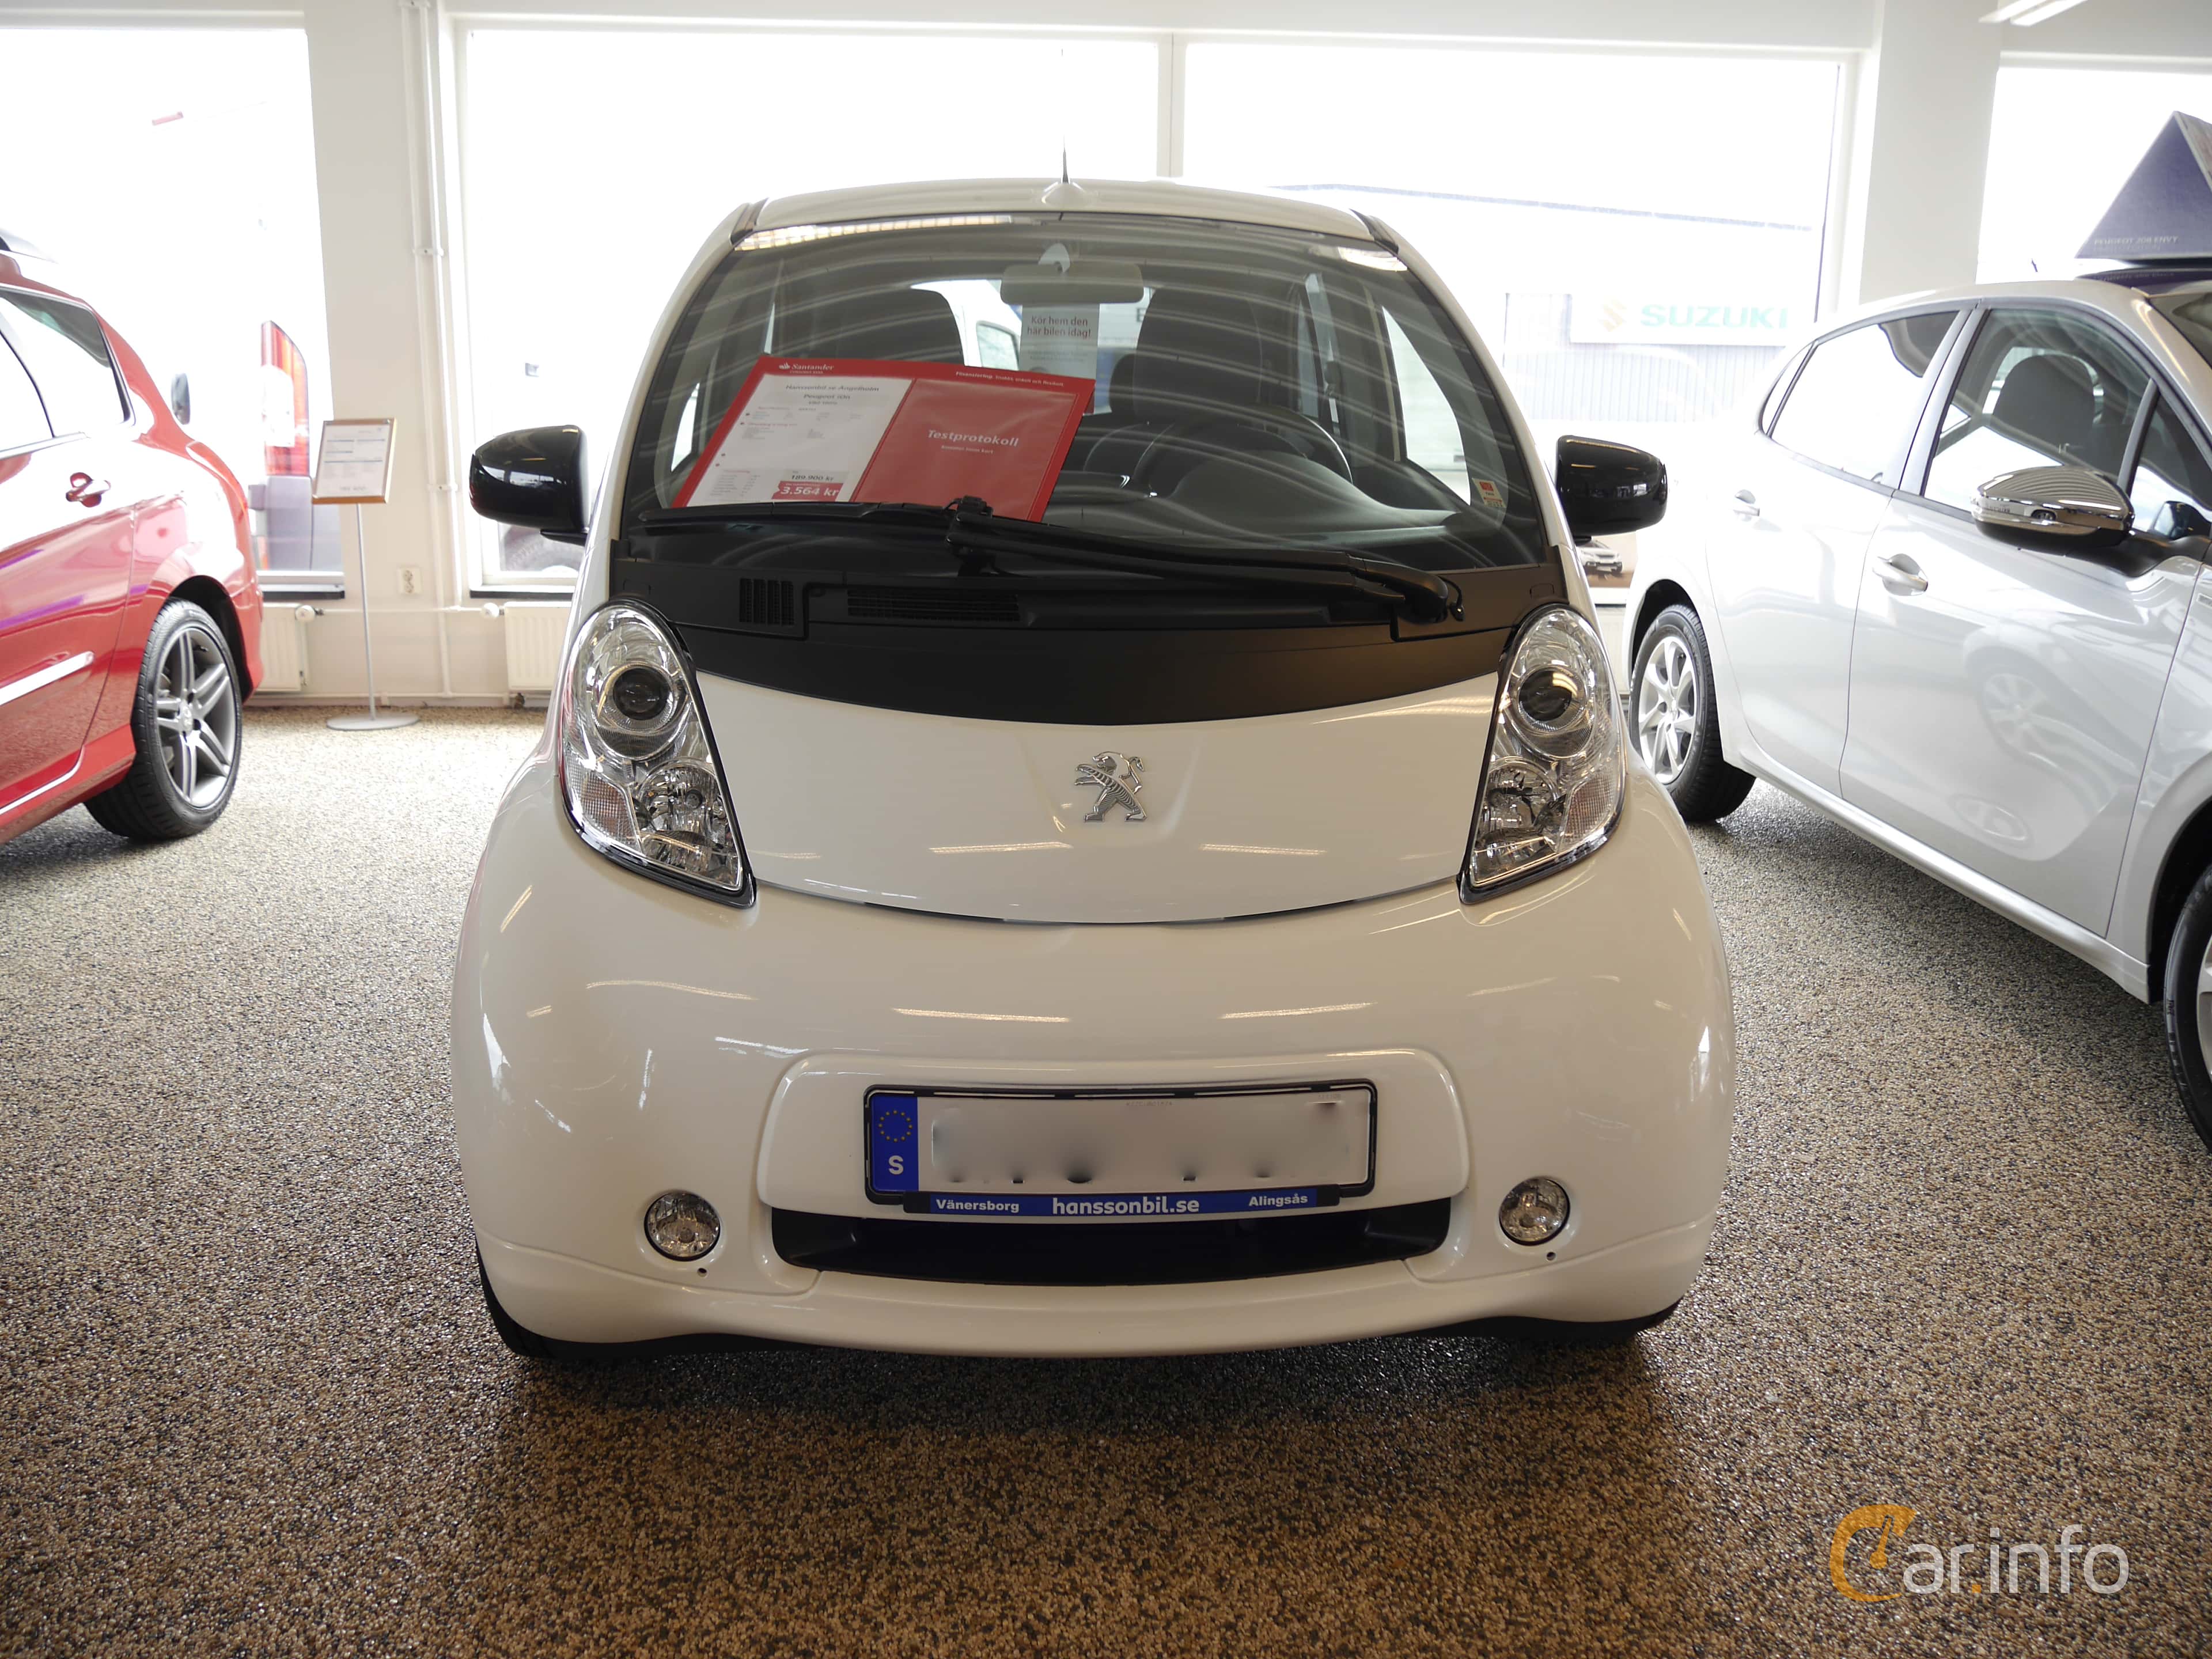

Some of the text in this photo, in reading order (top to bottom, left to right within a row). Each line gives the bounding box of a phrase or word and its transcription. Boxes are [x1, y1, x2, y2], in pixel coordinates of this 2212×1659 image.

[1048, 316, 1069, 325] hem
[1070, 316, 1088, 327] den
[1640, 304, 1789, 328] SUZUKI
[1043, 327, 1066, 336] bilen
[1068, 327, 1091, 339] idag!
[927, 429, 1020, 447] Testprotokoll
[780, 486, 840, 497] 3.564 kr
[888, 1155, 904, 1175] S
[935, 1199, 1020, 1214] Vänersborg
[1052, 1196, 1200, 1214] hanssonbil.se
[1248, 1193, 1309, 1207] Alingsås
